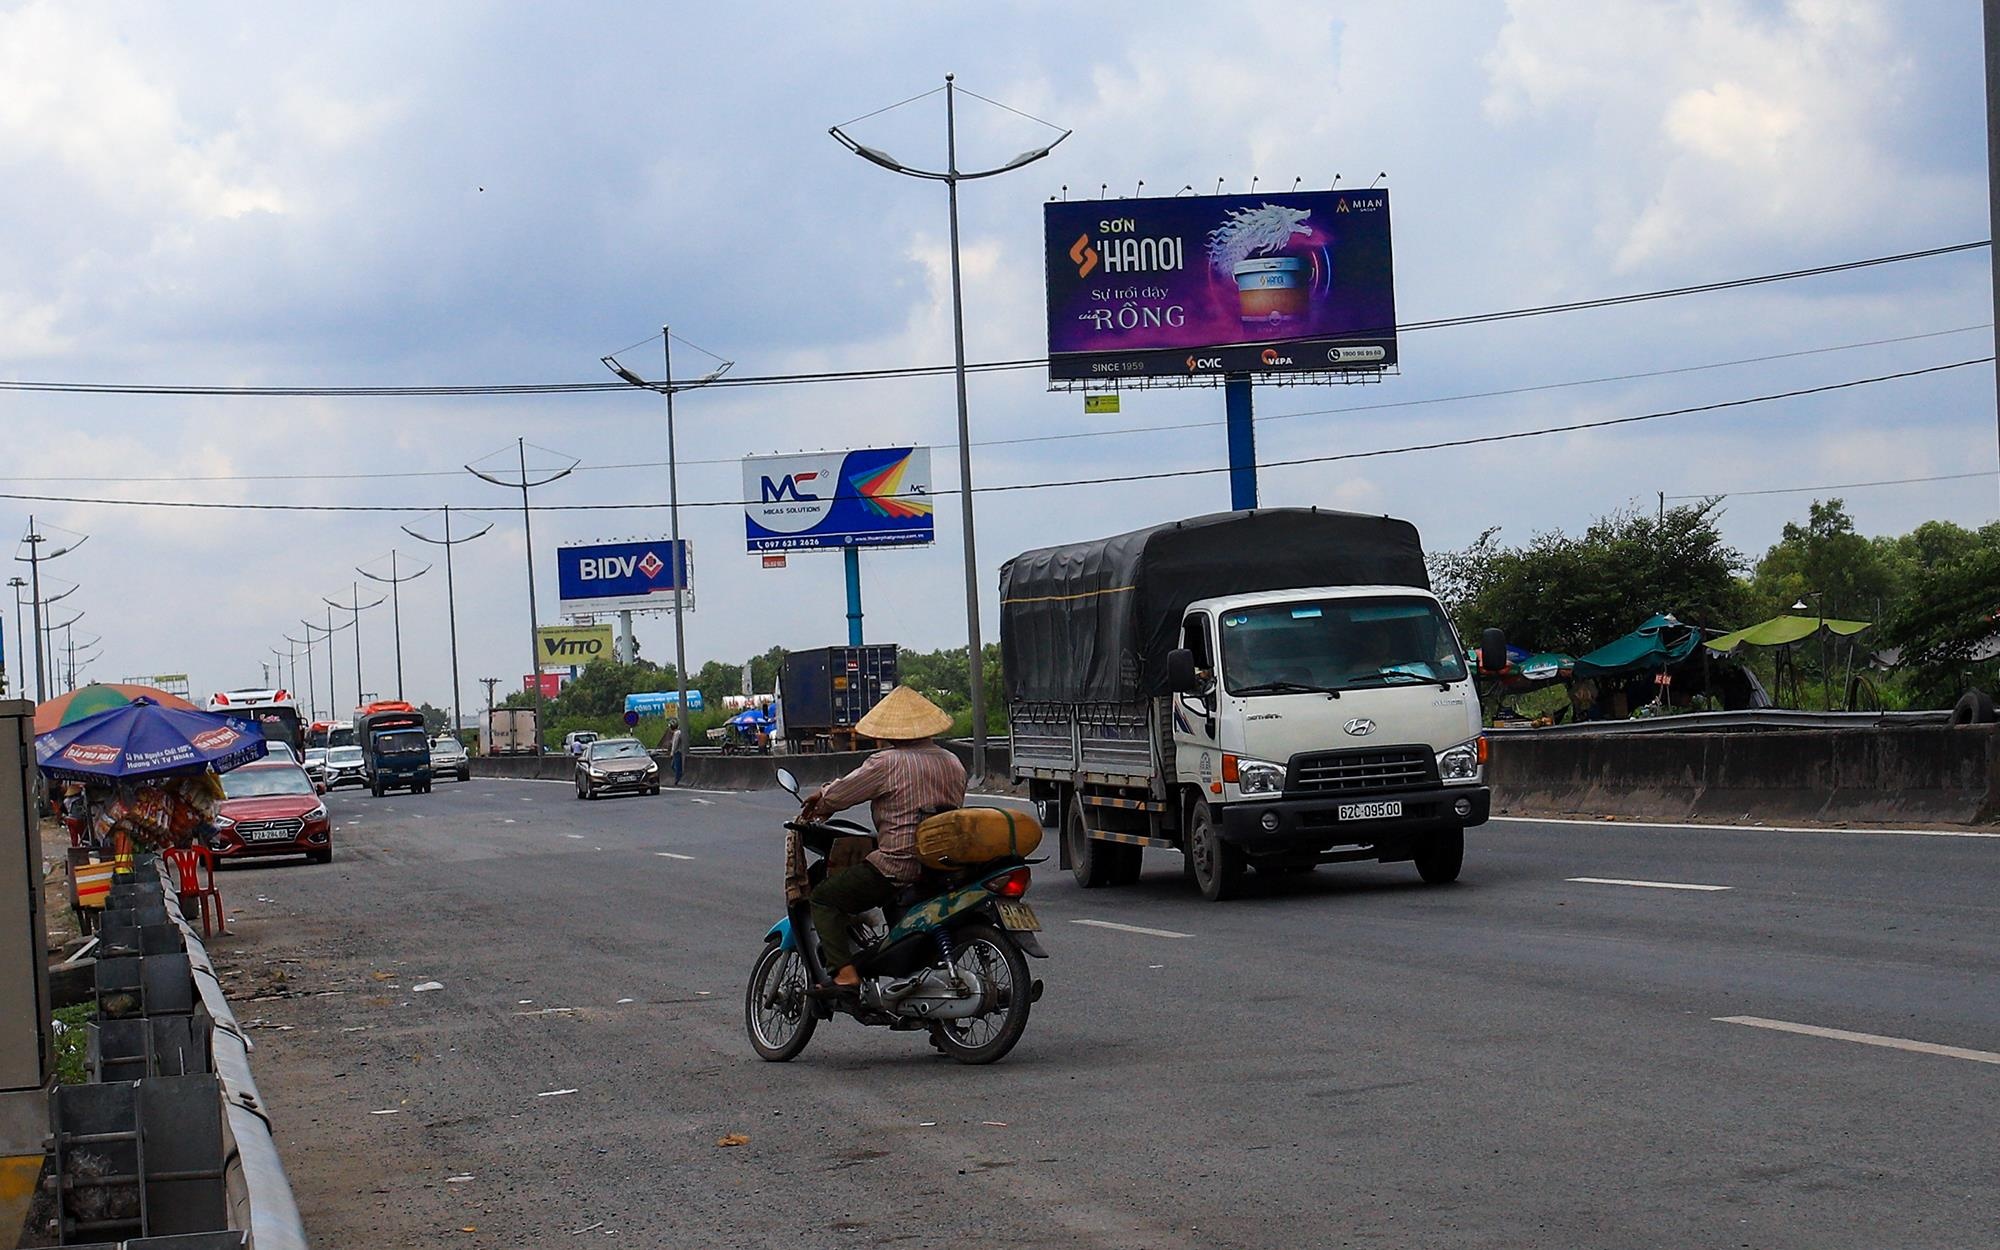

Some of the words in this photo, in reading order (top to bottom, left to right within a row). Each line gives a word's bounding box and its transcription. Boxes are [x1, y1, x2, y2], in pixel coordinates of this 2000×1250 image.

[1352, 200, 1383, 208] MIAN
[1099, 217, 1136, 234] SƠN
[1091, 287, 1111, 302] Sự
[1141, 285, 1169, 301] dậy
[1095, 300, 1186, 330] RỒNG
[1092, 362, 1120, 373] SINCE
[1121, 361, 1145, 371] 1959
[761, 472, 819, 504] MC
[786, 506, 820, 514] SOLUTIONS
[579, 555, 637, 580] BIDV
